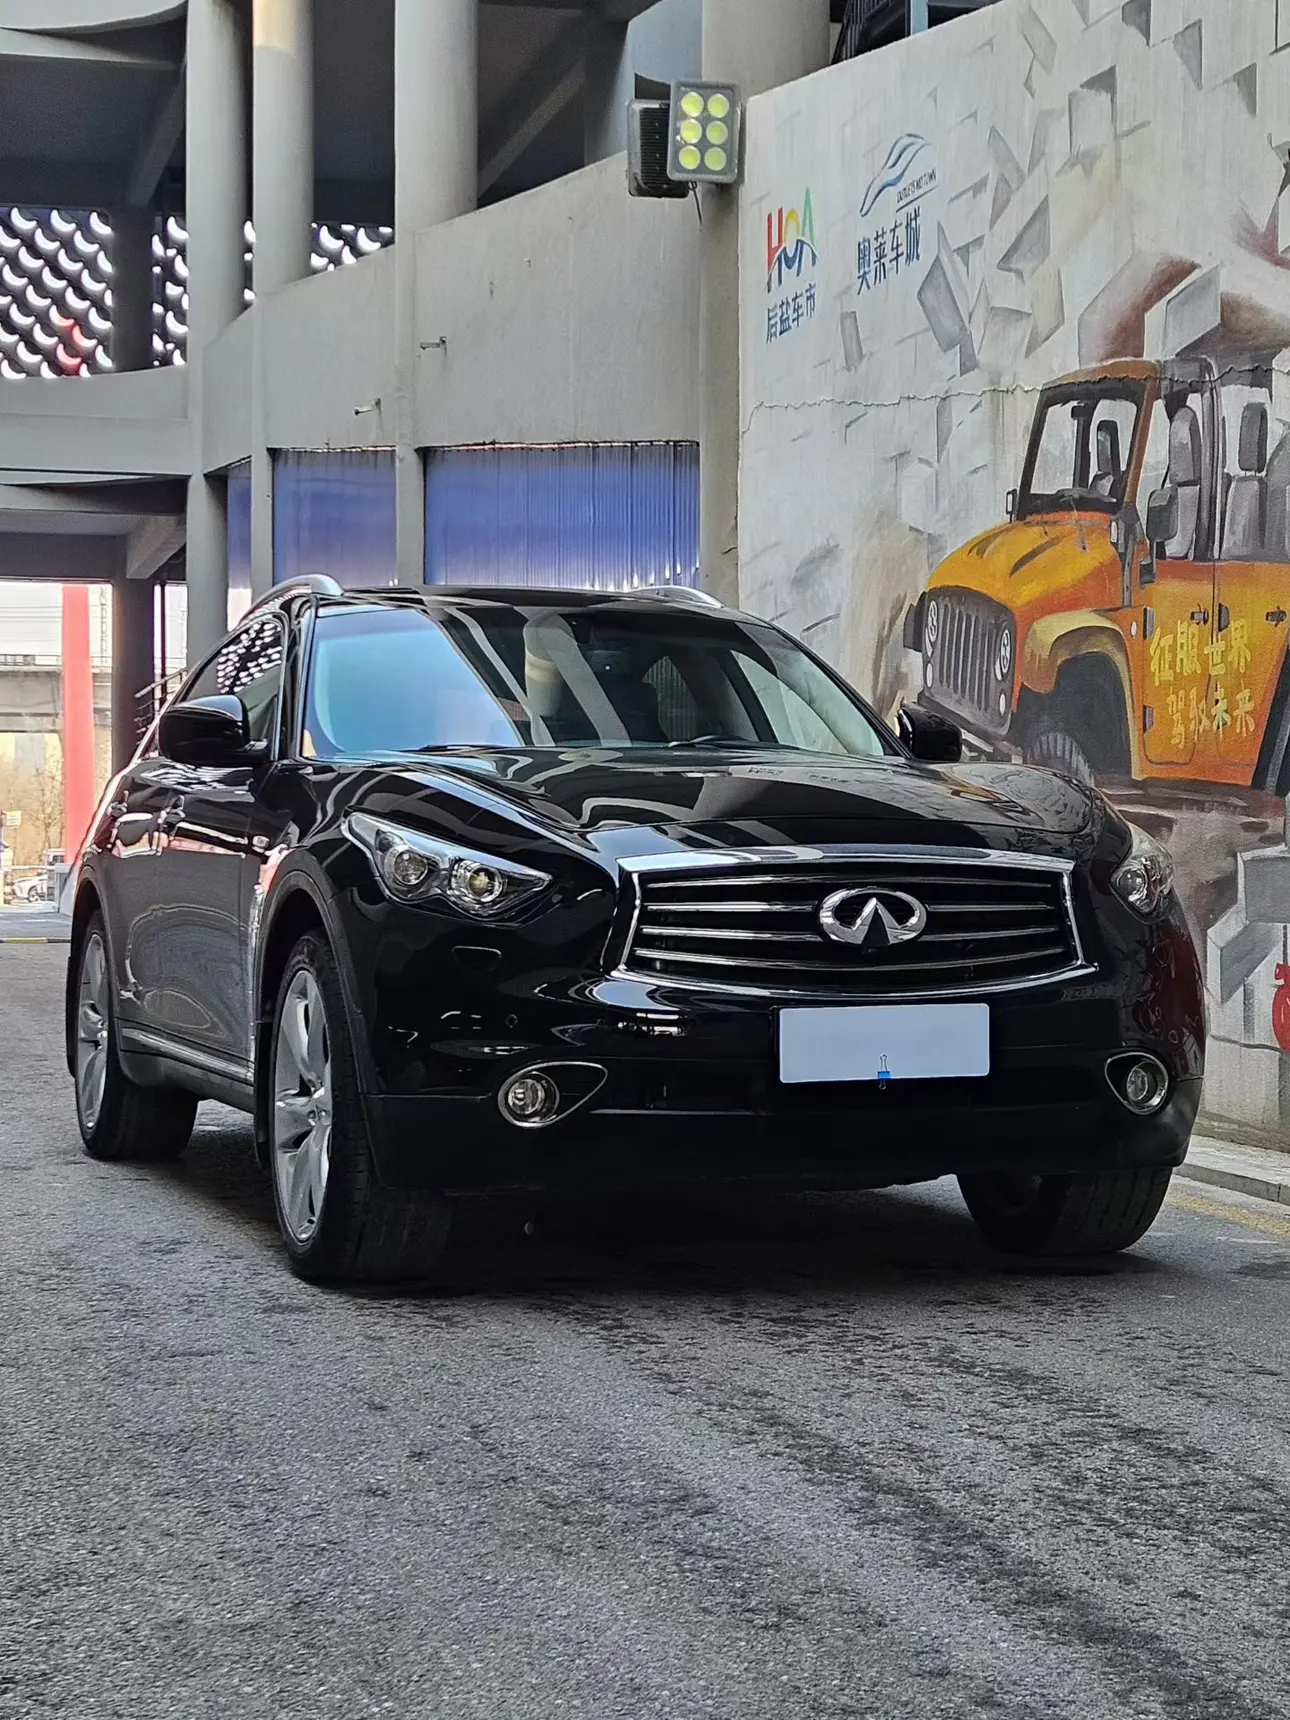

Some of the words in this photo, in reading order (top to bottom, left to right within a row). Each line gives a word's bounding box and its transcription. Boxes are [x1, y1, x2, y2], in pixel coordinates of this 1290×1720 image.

[857, 205, 920, 295] 奥莱车城
[766, 283, 816, 344] 后盐车市
[1150, 618, 1251, 687] 征服世界
[1166, 679, 1255, 748] 驾驭未来
